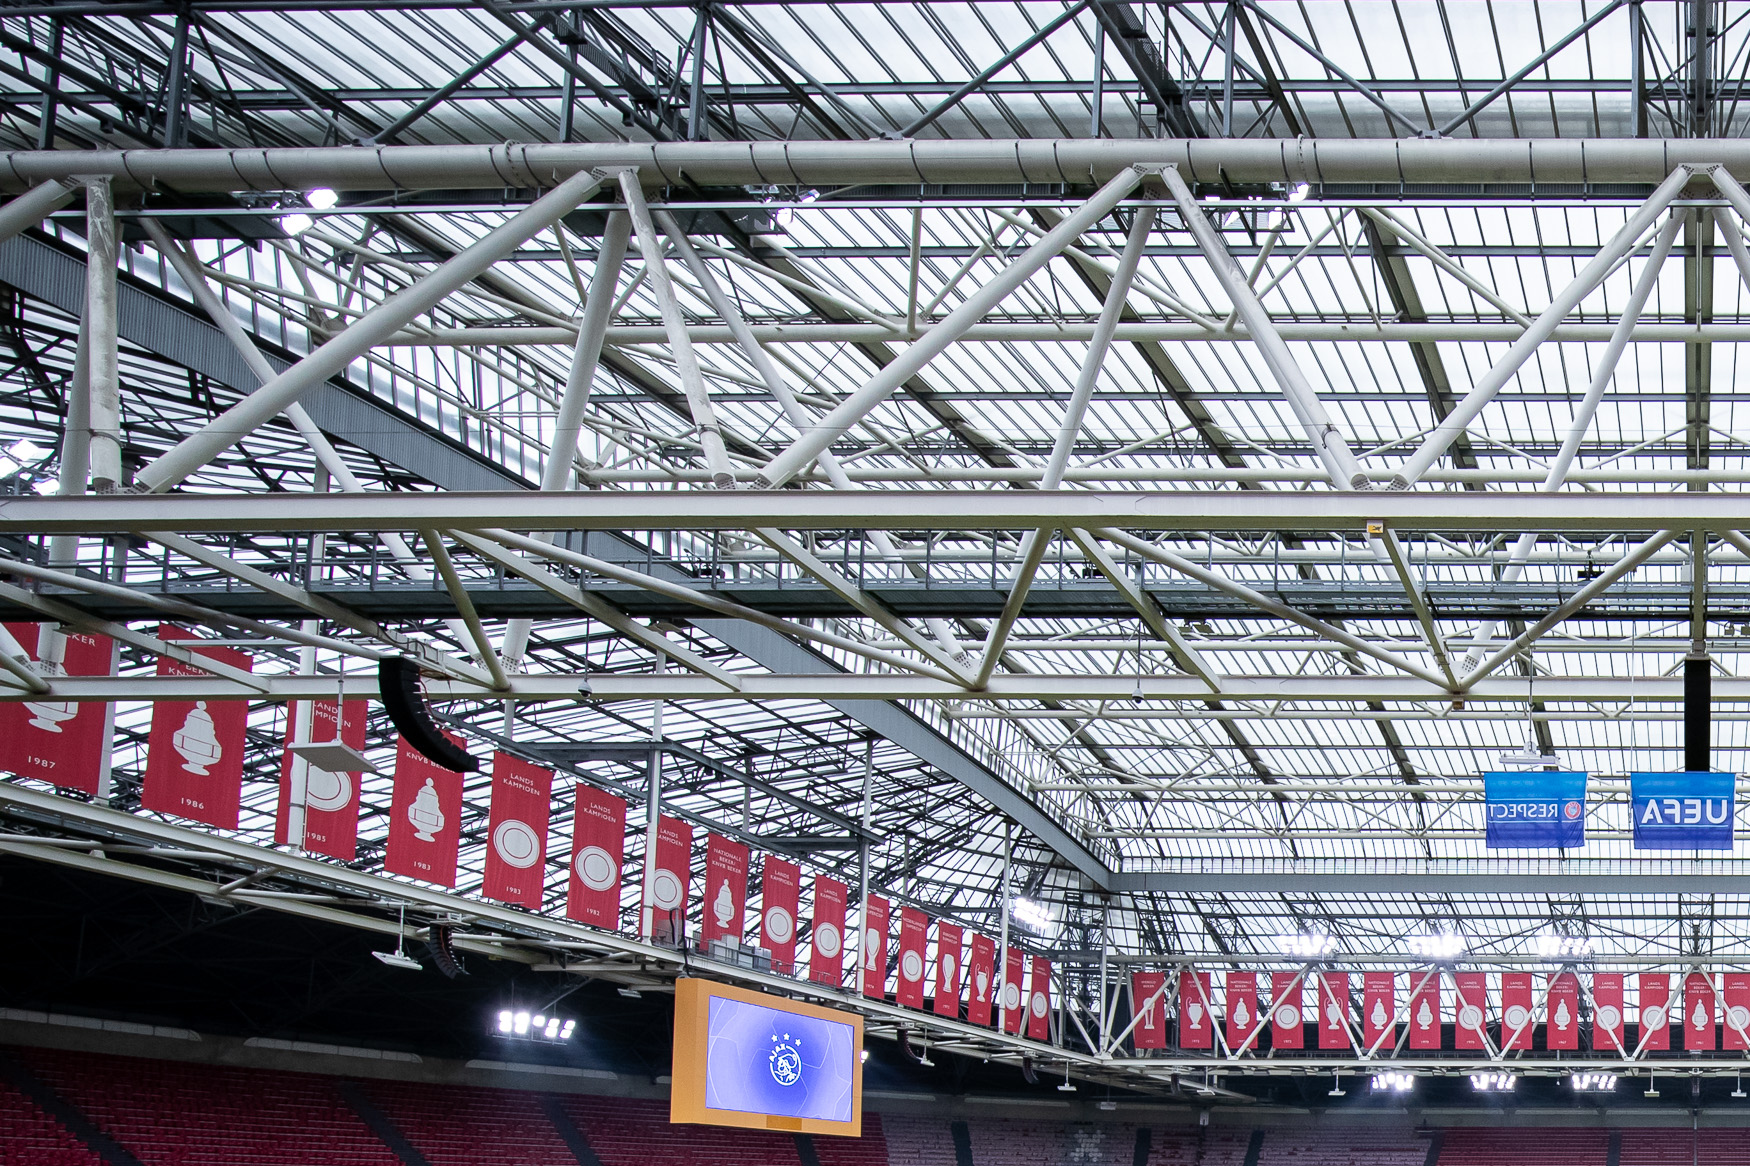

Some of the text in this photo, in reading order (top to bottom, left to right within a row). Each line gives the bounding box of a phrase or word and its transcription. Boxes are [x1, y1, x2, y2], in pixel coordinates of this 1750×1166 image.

[28, 756, 56, 768] 1987
[510, 772, 534, 786] LANDS
[503, 778, 540, 796] KAMPIOEN
[180, 798, 204, 810] 1986
[590, 802, 611, 814] LANDS
[583, 807, 616, 823] KAMPIOEN
[307, 831, 326, 843] 1985
[660, 828, 679, 838] LANDS
[658, 834, 684, 847] AMPIOEN
[713, 848, 742, 862] NATIONALE
[413, 860, 431, 870] 1983
[506, 886, 521, 894] 1983
[586, 908, 600, 916] 1982
[768, 1043, 786, 1062] AJAX
